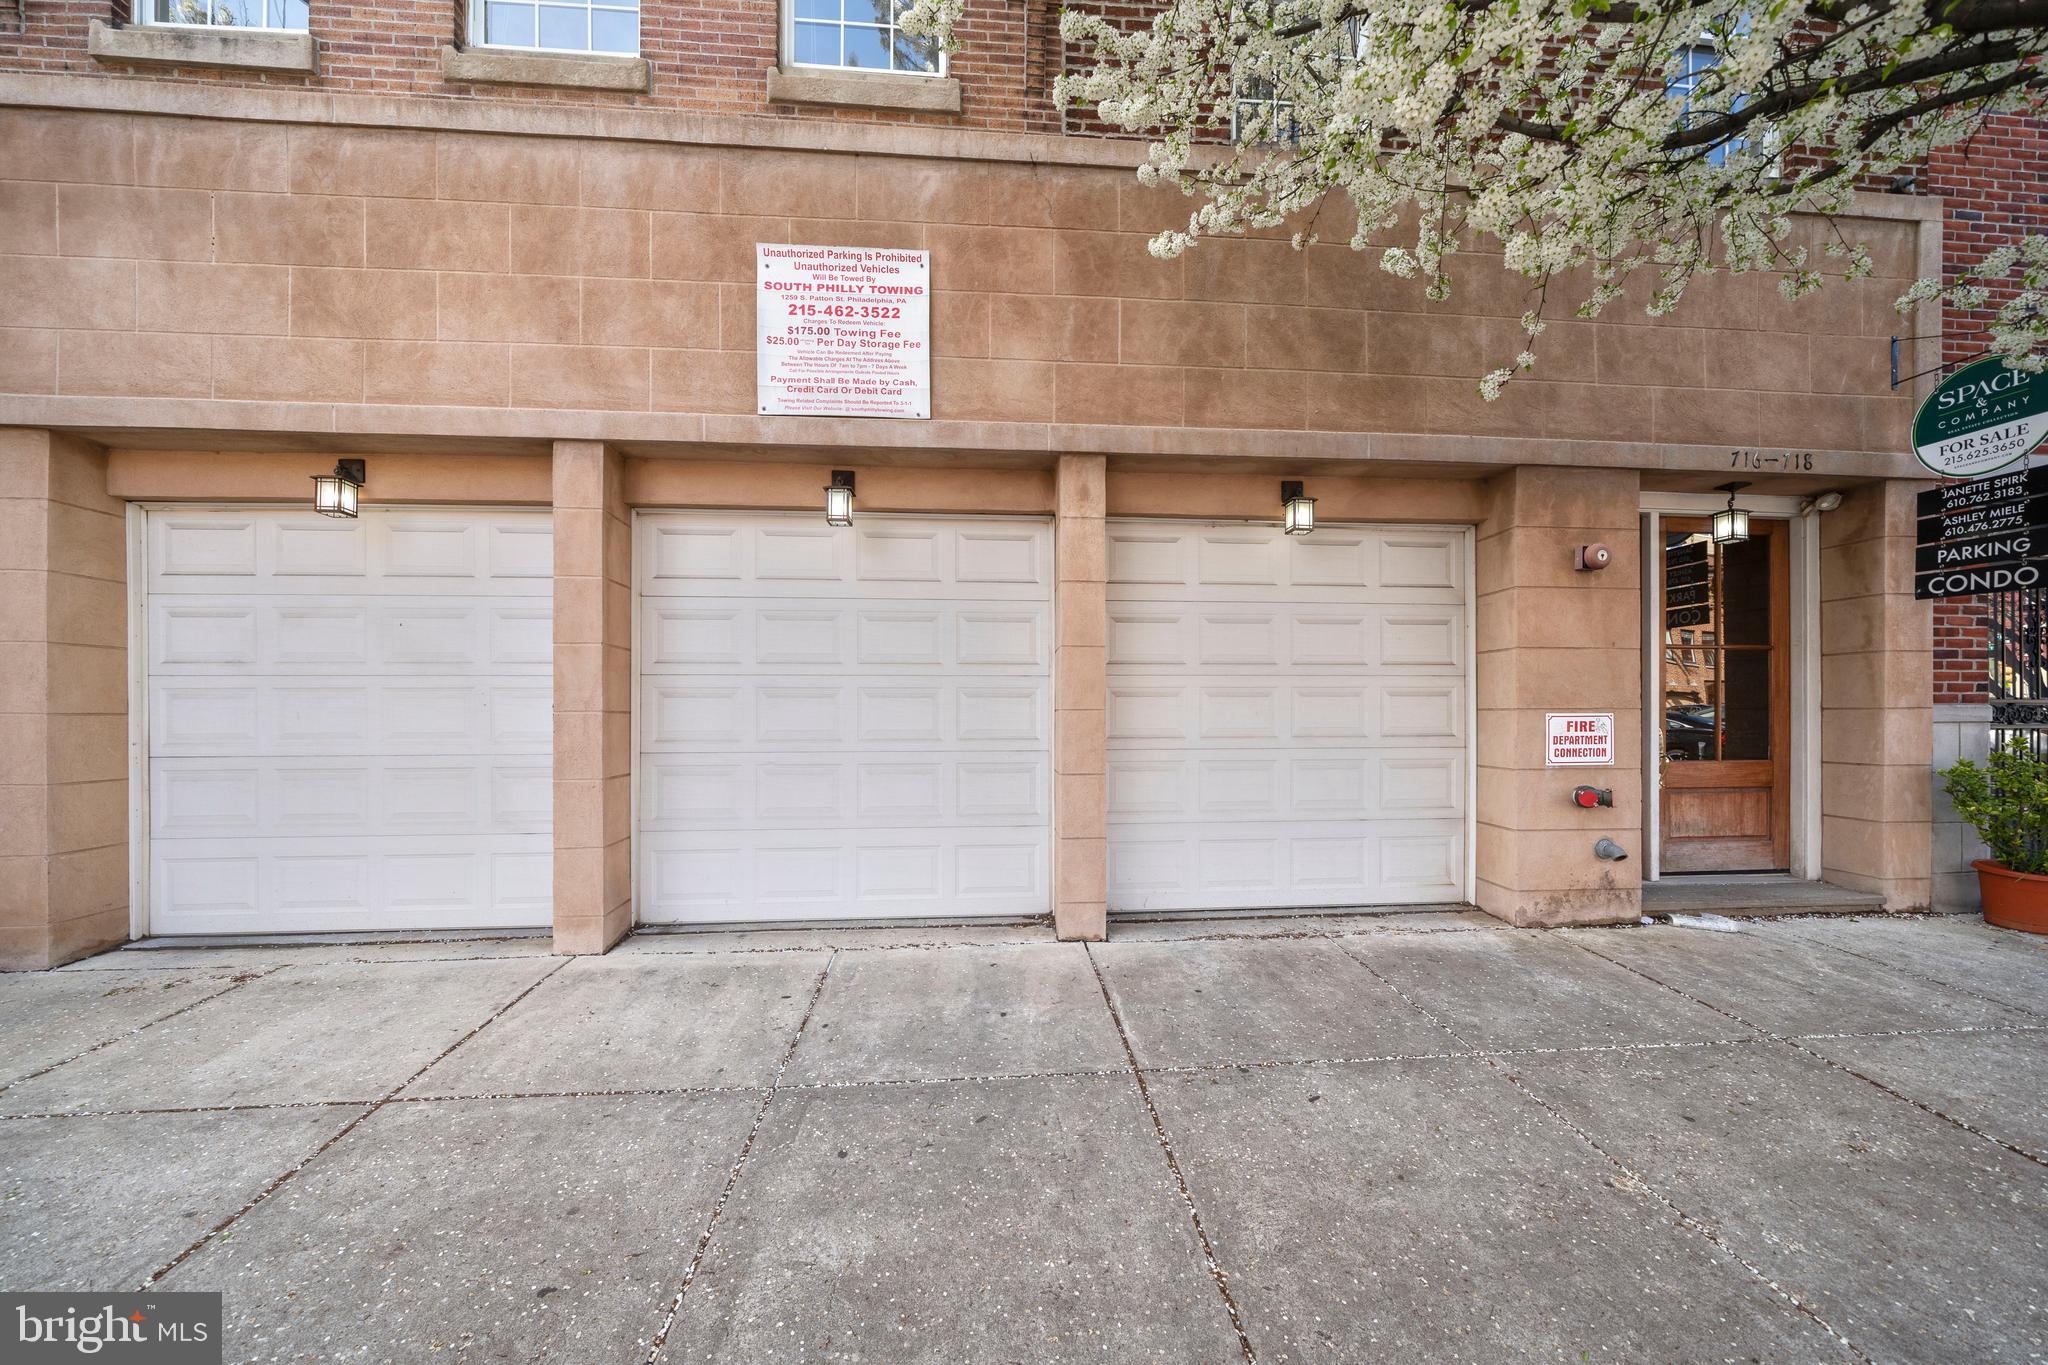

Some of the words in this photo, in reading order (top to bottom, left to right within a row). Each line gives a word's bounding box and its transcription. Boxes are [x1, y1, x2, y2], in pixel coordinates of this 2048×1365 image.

[763, 248, 824, 259] Unauthorized
[828, 250, 862, 262] Parking
[865, 252, 872, 260] Is
[876, 253, 922, 262] Prohibited
[794, 262, 857, 272] Unauthorized
[861, 264, 899, 274] Vehicles
[764, 281, 812, 291] SOUTH
[817, 283, 864, 293] PHILLY
[870, 285, 923, 295] TOWING
[848, 296, 894, 304] Philadelphia,
[788, 304, 900, 318] 215-462-3522
[788, 326, 830, 336] $175.00
[834, 328, 876, 339] Towing
[880, 330, 901, 338] Fee
[767, 336, 799, 346] $25.00
[817, 338, 834, 347] Per
[838, 339, 857, 349] Day
[860, 339, 900, 350] Storage
[903, 341, 921, 349] Fee
[771, 376, 811, 384] Payment
[893, 379, 917, 387] Cash,
[787, 385, 814, 393] Credit
[817, 386, 838, 394] Card
[855, 387, 878, 395] Debit
[1938, 369, 2030, 409] SPACE
[1975, 397, 1988, 408] &
[1938, 396, 2030, 429] COMPANY
[1939, 438, 1975, 456] FOR
[1980, 423, 2030, 445] SALE
[1944, 438, 2025, 466] 215.625.3650
[1731, 451, 1813, 470] 716-718
[1942, 481, 1990, 499] JANETTE
[1994, 474, 2028, 488] SPIRK
[1947, 486, 2023, 508] 610.762.3183
[1943, 511, 1986, 527] ASHLEY
[1990, 504, 2025, 518] MIELE
[1945, 516, 2023, 537] 610.476.2775
[1938, 538, 2031, 563] PARKING
[1928, 566, 2039, 594] CONDO
[1567, 721, 1595, 732] FIRE
[1553, 735, 1608, 745] DEPARTMENT
[1554, 748, 1607, 757] CONNECTION
